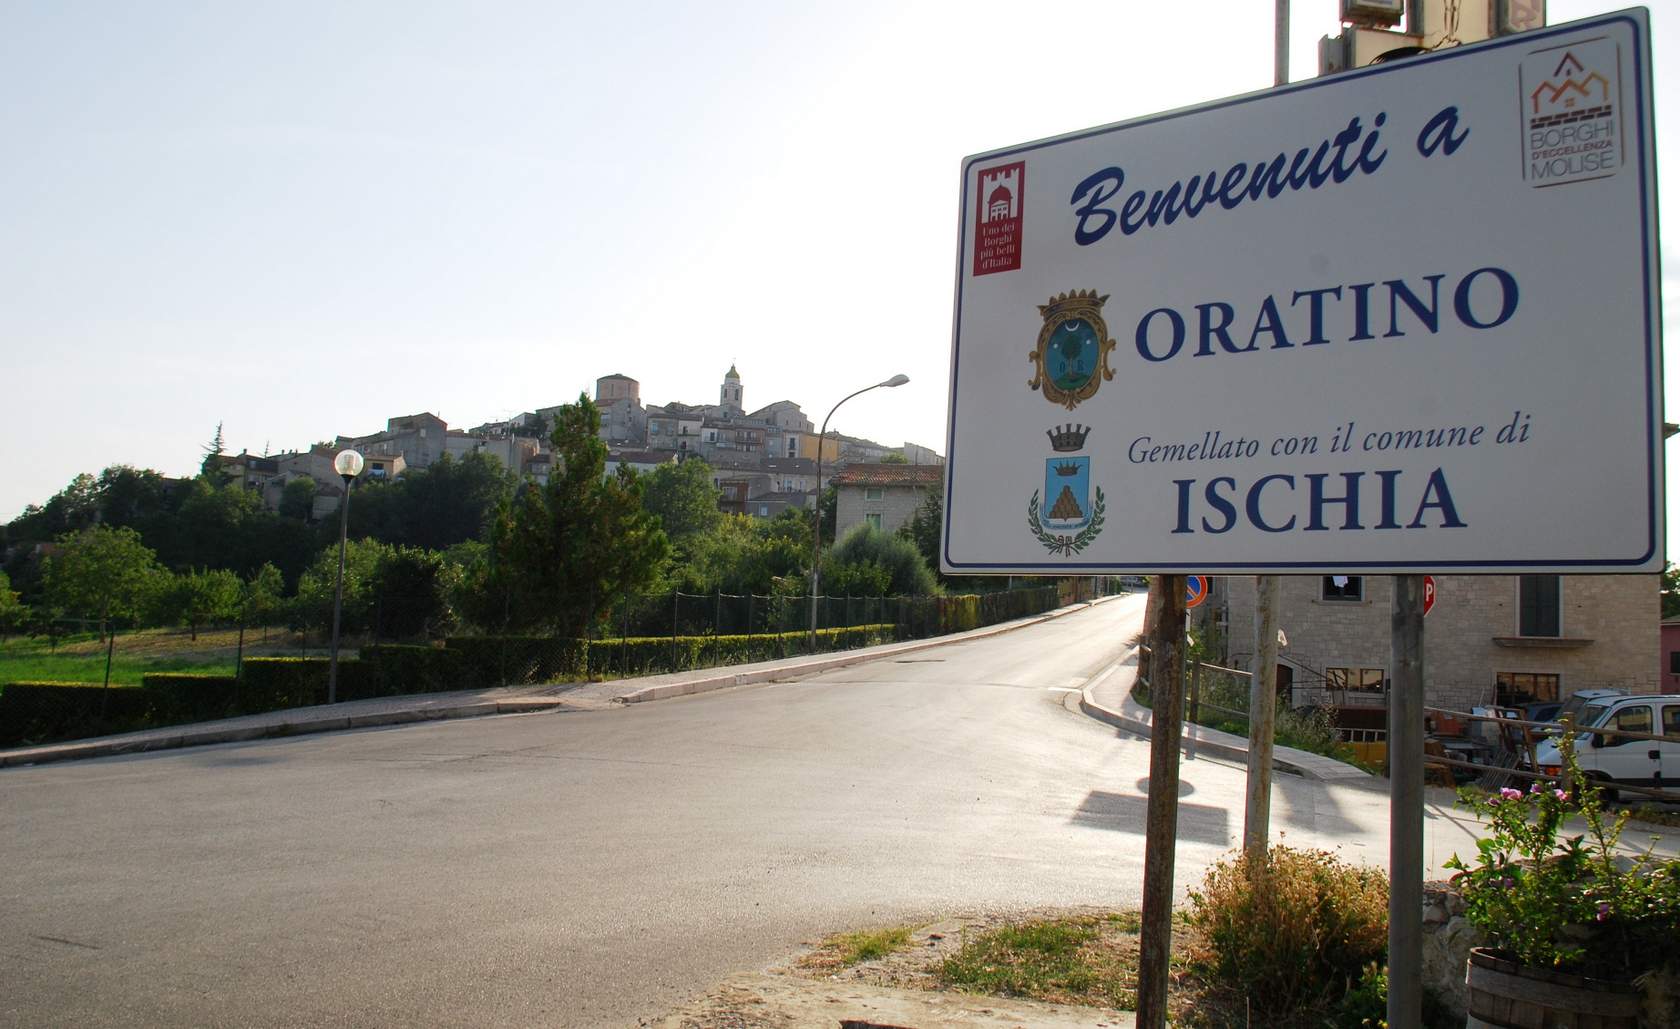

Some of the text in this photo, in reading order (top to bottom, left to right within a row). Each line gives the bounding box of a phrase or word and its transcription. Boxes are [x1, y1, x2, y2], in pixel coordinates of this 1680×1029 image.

[1530, 120, 1614, 150] BORGHI
[1531, 139, 1613, 160] D'ECCELLENZA
[1070, 105, 1470, 246] Benvenuti a
[1531, 151, 1614, 180] MOLISE
[983, 222, 1015, 236] Uno dei
[984, 233, 1012, 247] Borghi
[980, 243, 1015, 261] più belli
[982, 256, 1012, 269] d'Italia
[1135, 267, 1519, 362] ORATINO
[1128, 411, 1531, 464] Gemellato con il comune di
[1171, 467, 1468, 534] ISCHIA
